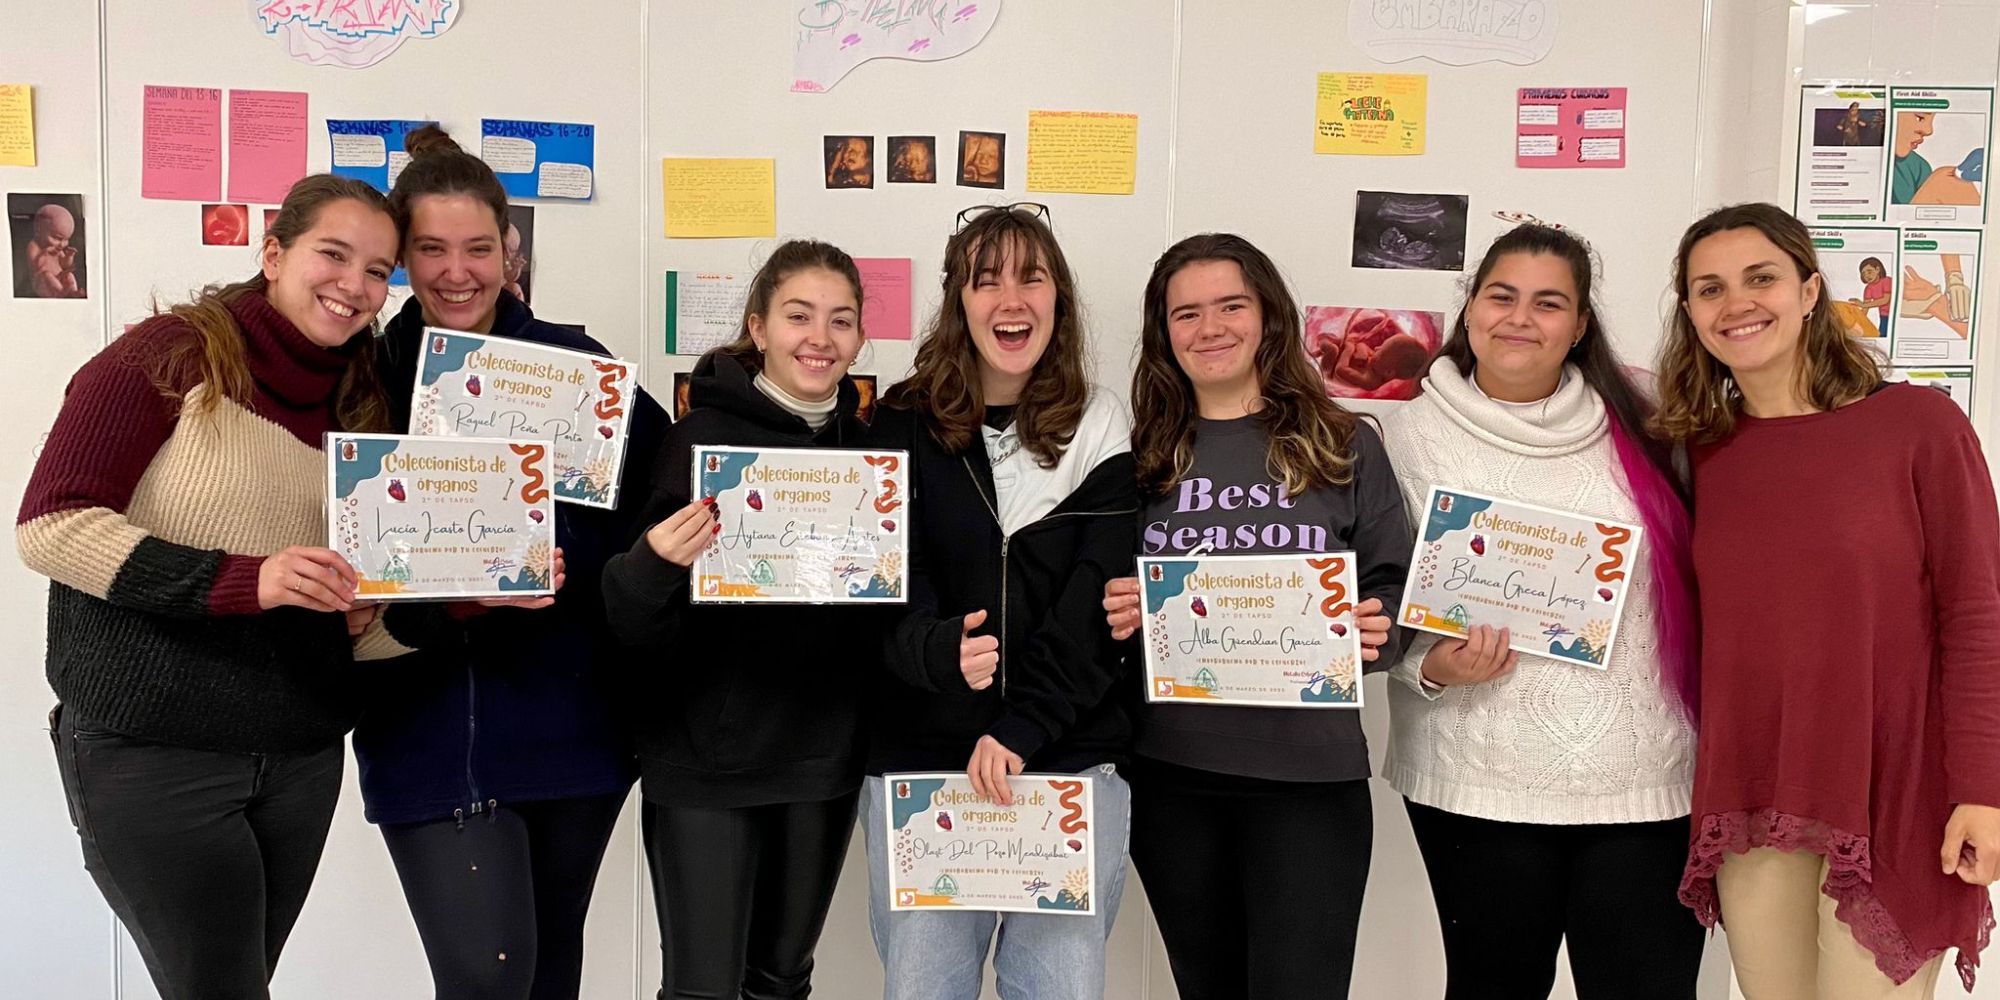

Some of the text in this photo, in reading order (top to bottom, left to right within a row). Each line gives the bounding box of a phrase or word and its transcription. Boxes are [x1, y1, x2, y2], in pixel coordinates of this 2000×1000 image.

[469, 351, 585, 386] Coleccionista de
[449, 402, 497, 433] Raquel
[498, 410, 540, 437] Peña
[385, 453, 507, 473] Coleccionista de
[745, 465, 860, 484] Coleccionista de
[417, 478, 478, 494] órganos
[1172, 477, 1297, 514] Best
[377, 506, 418, 543] Lucía
[467, 509, 515, 543] García
[721, 513, 777, 550] Aytana
[1143, 519, 1328, 554] Season
[1473, 512, 1588, 548] Coleccionista de
[1187, 571, 1304, 591] Coleccionista de
[1443, 557, 1502, 591] Blanca
[1547, 576, 1587, 610] López
[1178, 619, 1220, 654] Alba
[1280, 626, 1323, 654] García
[1028, 790, 1045, 807] de
[943, 839, 976, 860] Del
